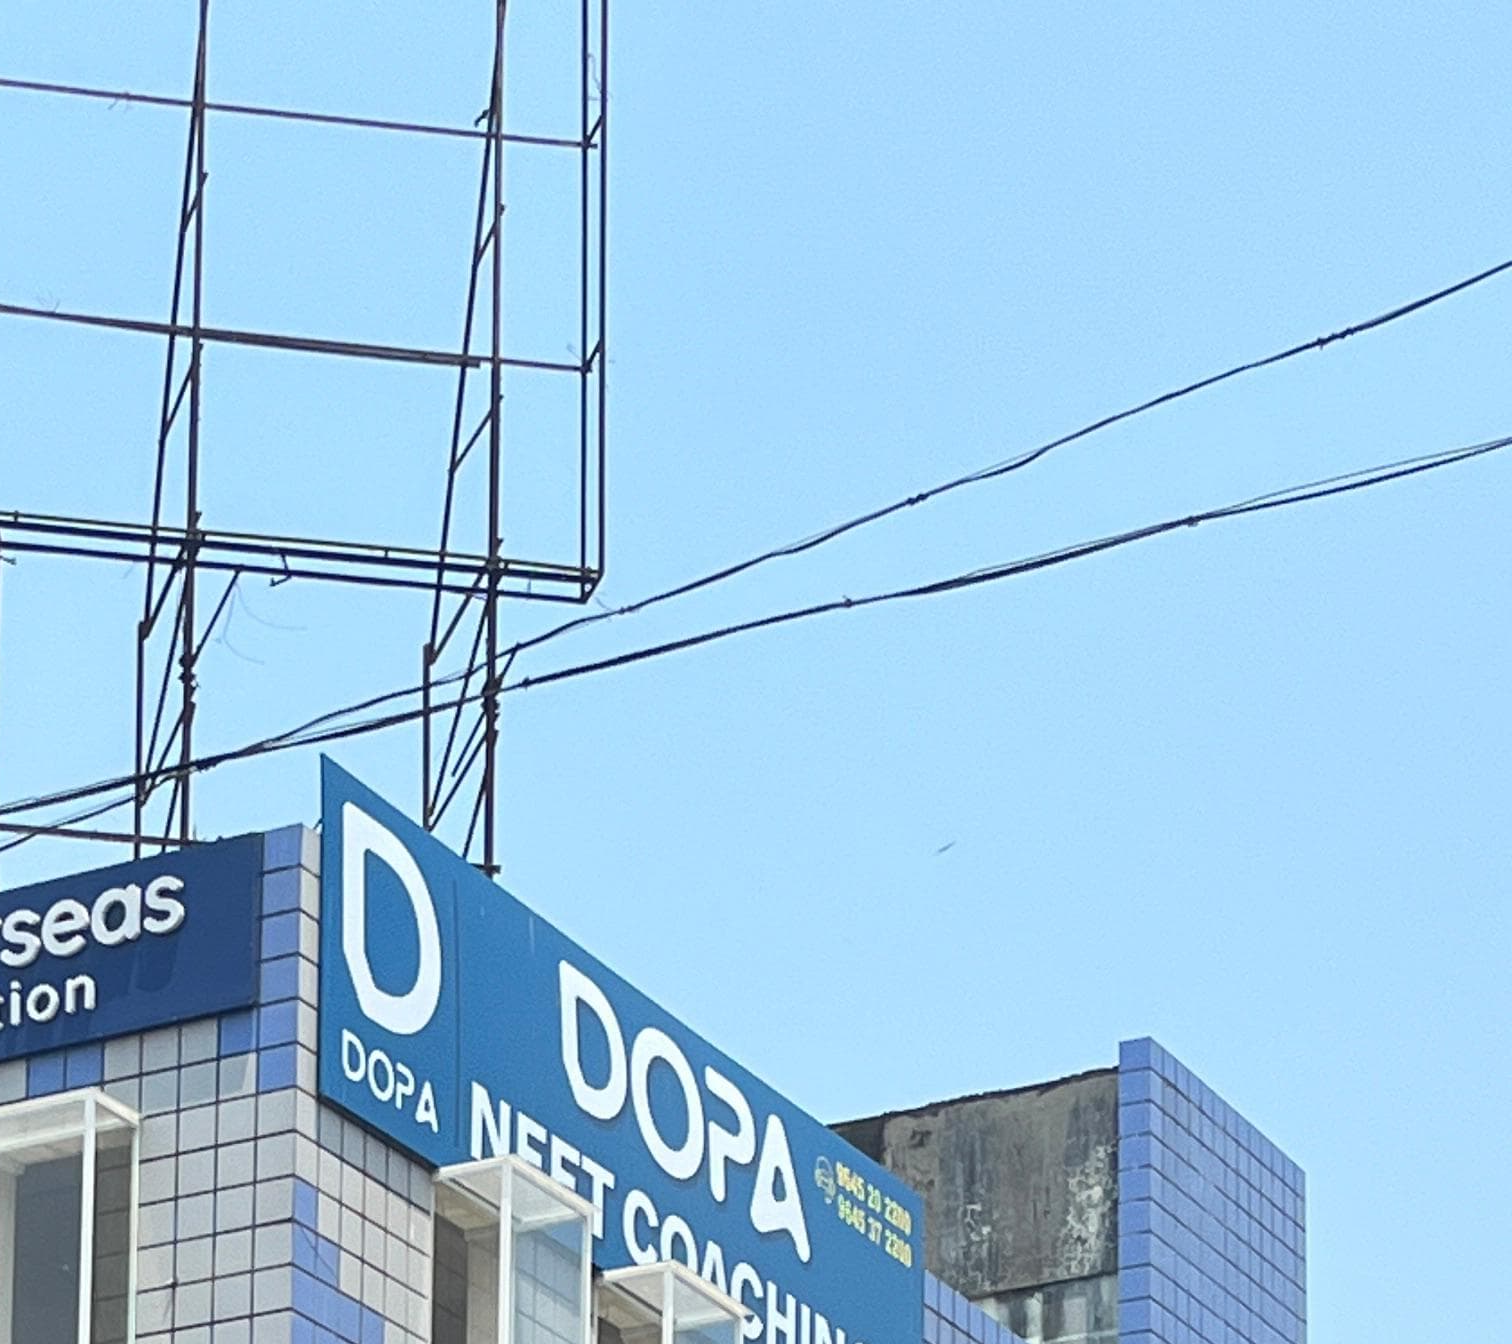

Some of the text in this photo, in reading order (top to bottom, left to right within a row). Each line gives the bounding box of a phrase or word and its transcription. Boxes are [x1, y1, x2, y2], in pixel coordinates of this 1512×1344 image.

[342, 1029, 438, 1133] DOPA
[471, 1080, 615, 1240] NEET
[559, 960, 811, 1263] DOPA
